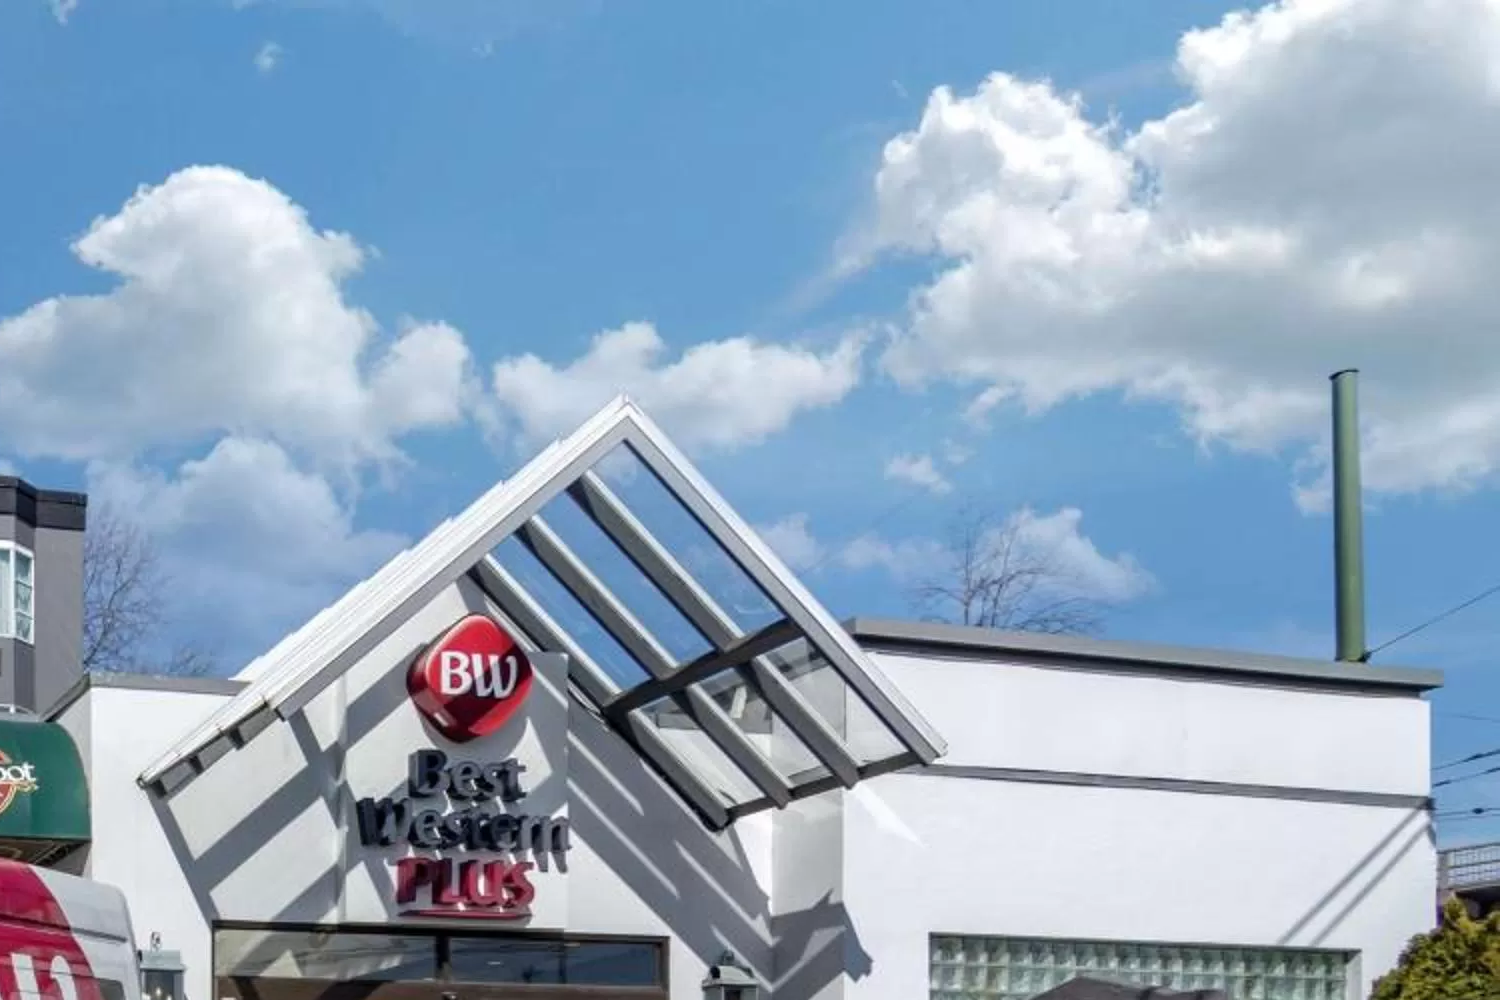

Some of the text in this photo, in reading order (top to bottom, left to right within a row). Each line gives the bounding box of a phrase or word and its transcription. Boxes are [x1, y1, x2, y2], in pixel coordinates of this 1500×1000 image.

[438, 650, 519, 699] BW
[408, 748, 526, 801] Best
[356, 797, 573, 855] Western
[396, 856, 535, 908] PLUS
